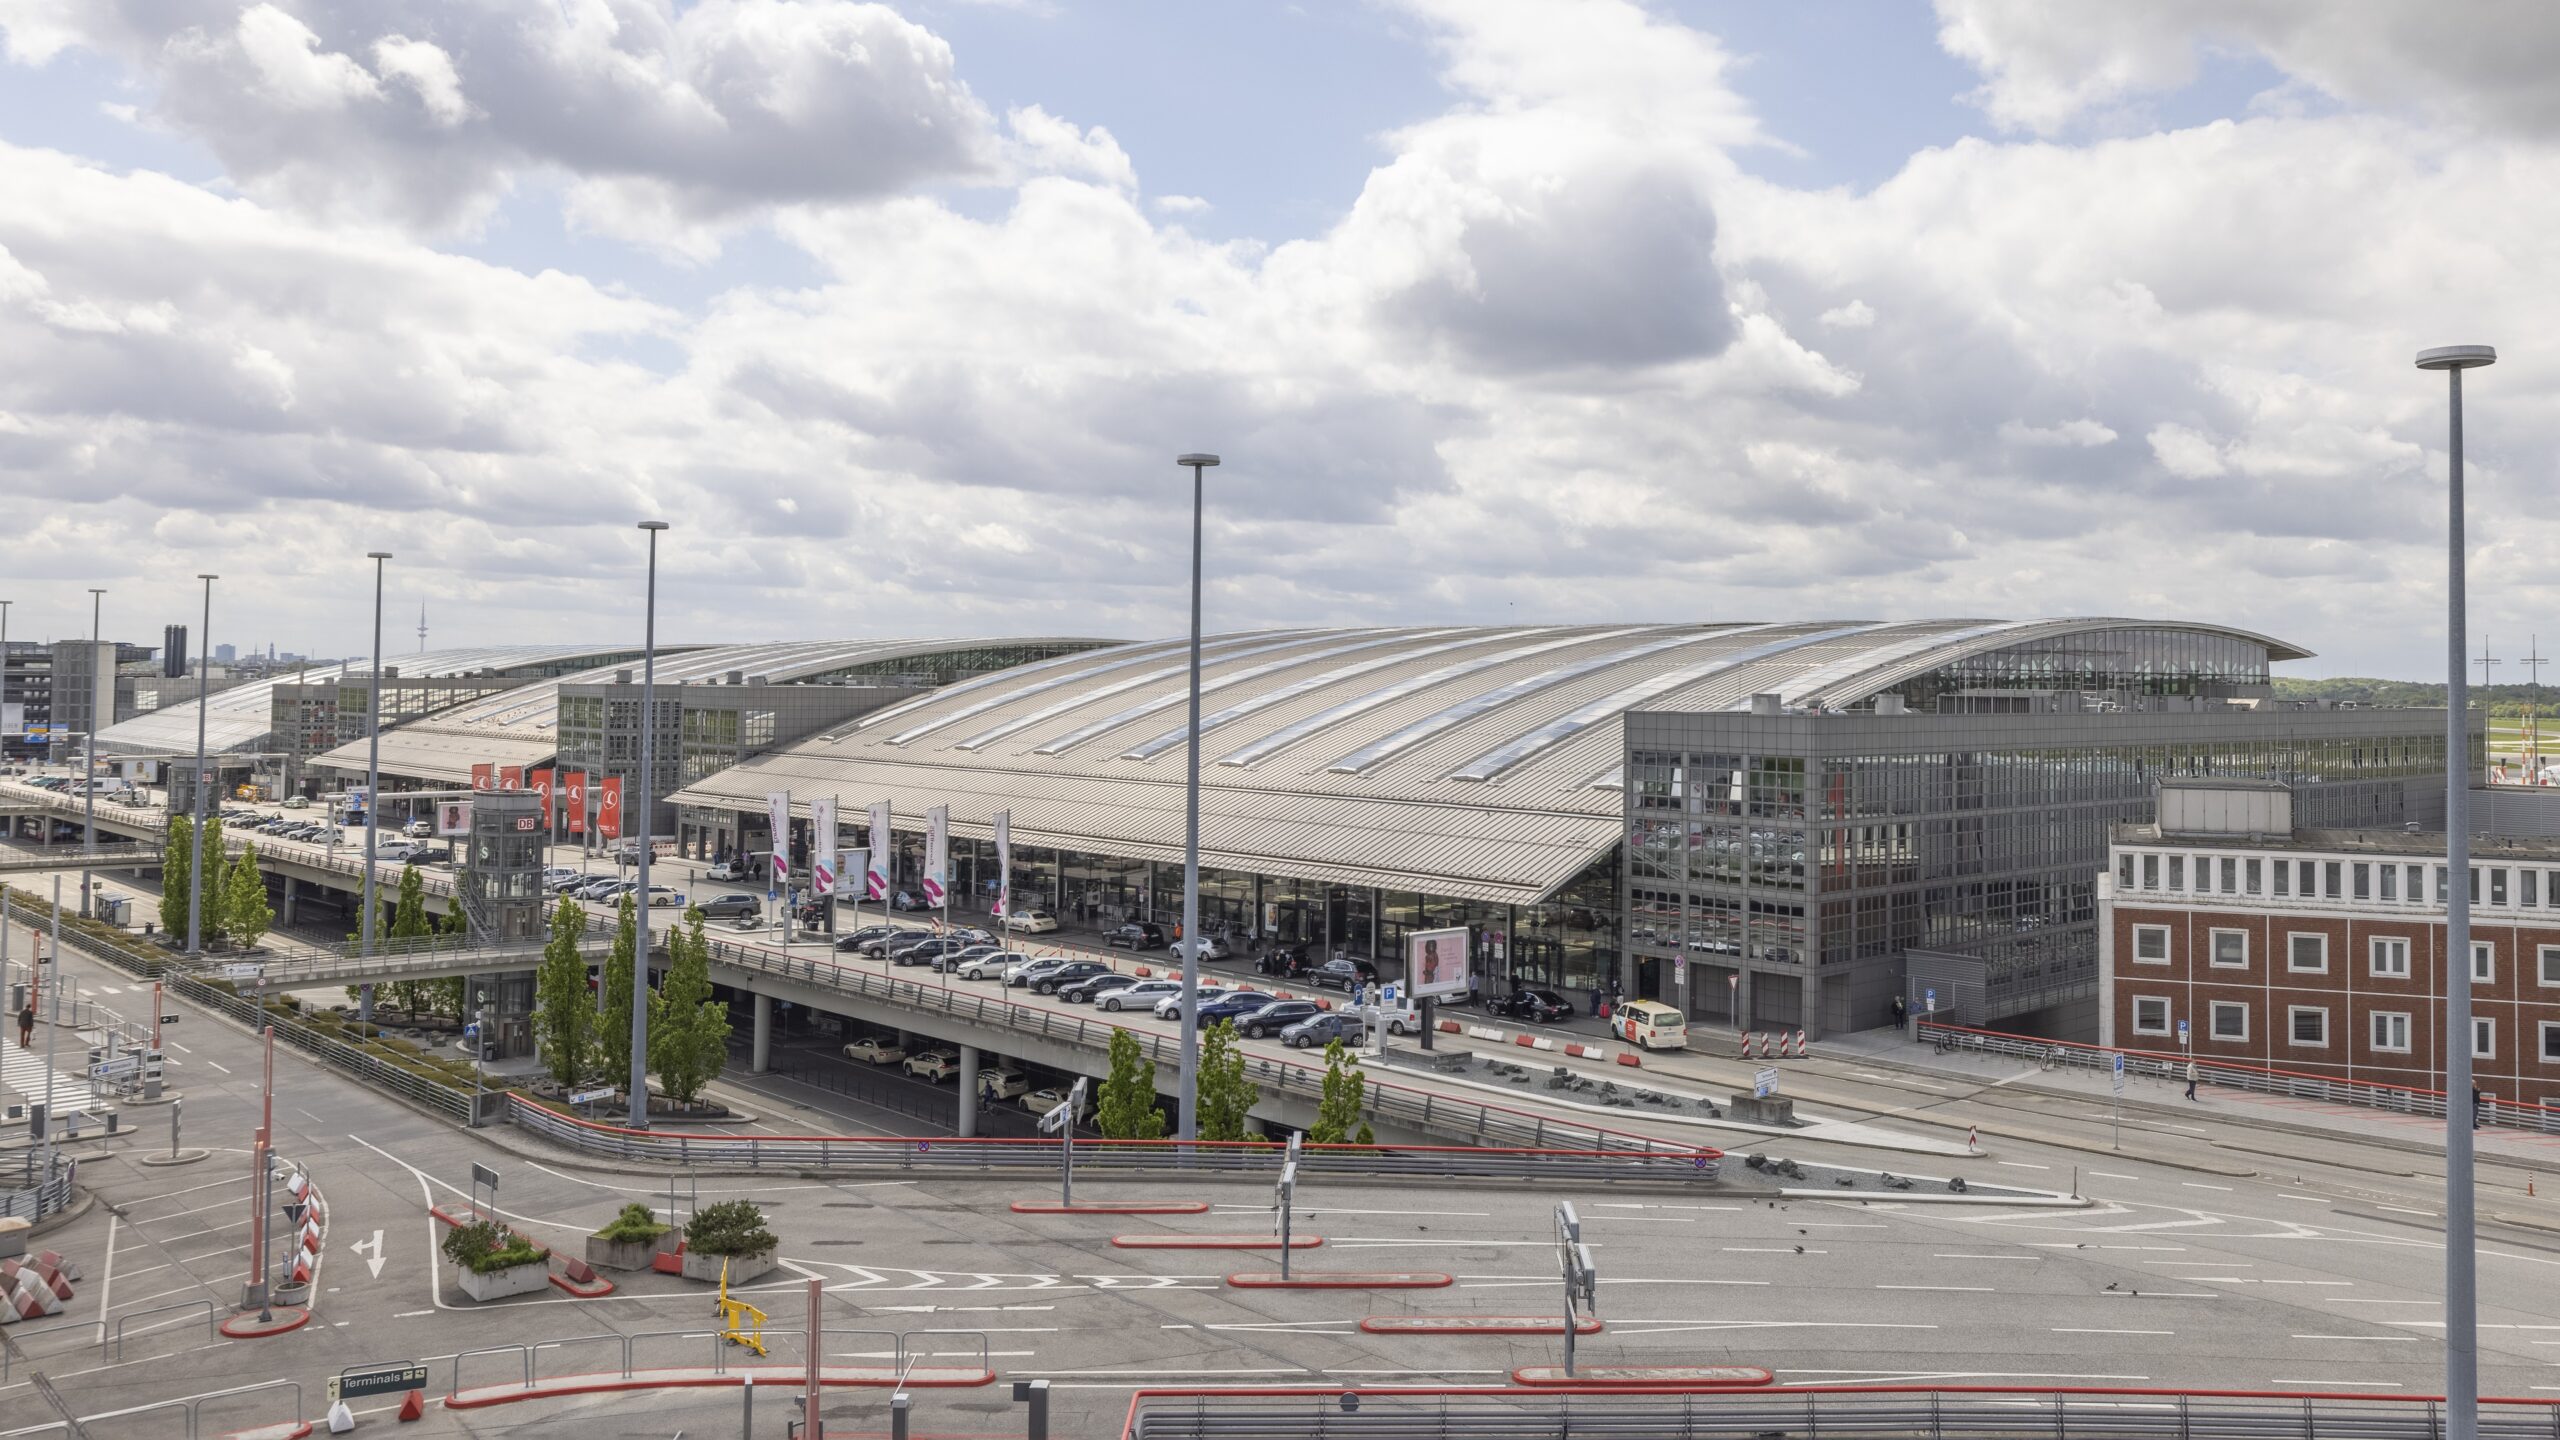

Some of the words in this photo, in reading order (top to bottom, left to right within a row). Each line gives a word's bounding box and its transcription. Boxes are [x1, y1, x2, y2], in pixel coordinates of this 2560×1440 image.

[519, 819, 533, 829] DB
[481, 846, 489, 859] S
[477, 990, 485, 1003] S
[1355, 989, 1362, 1001] P
[1386, 988, 1393, 999] P
[1927, 990, 1934, 998] P
[2180, 1021, 2187, 1030] P
[342, 1373, 401, 1388] Terminals
